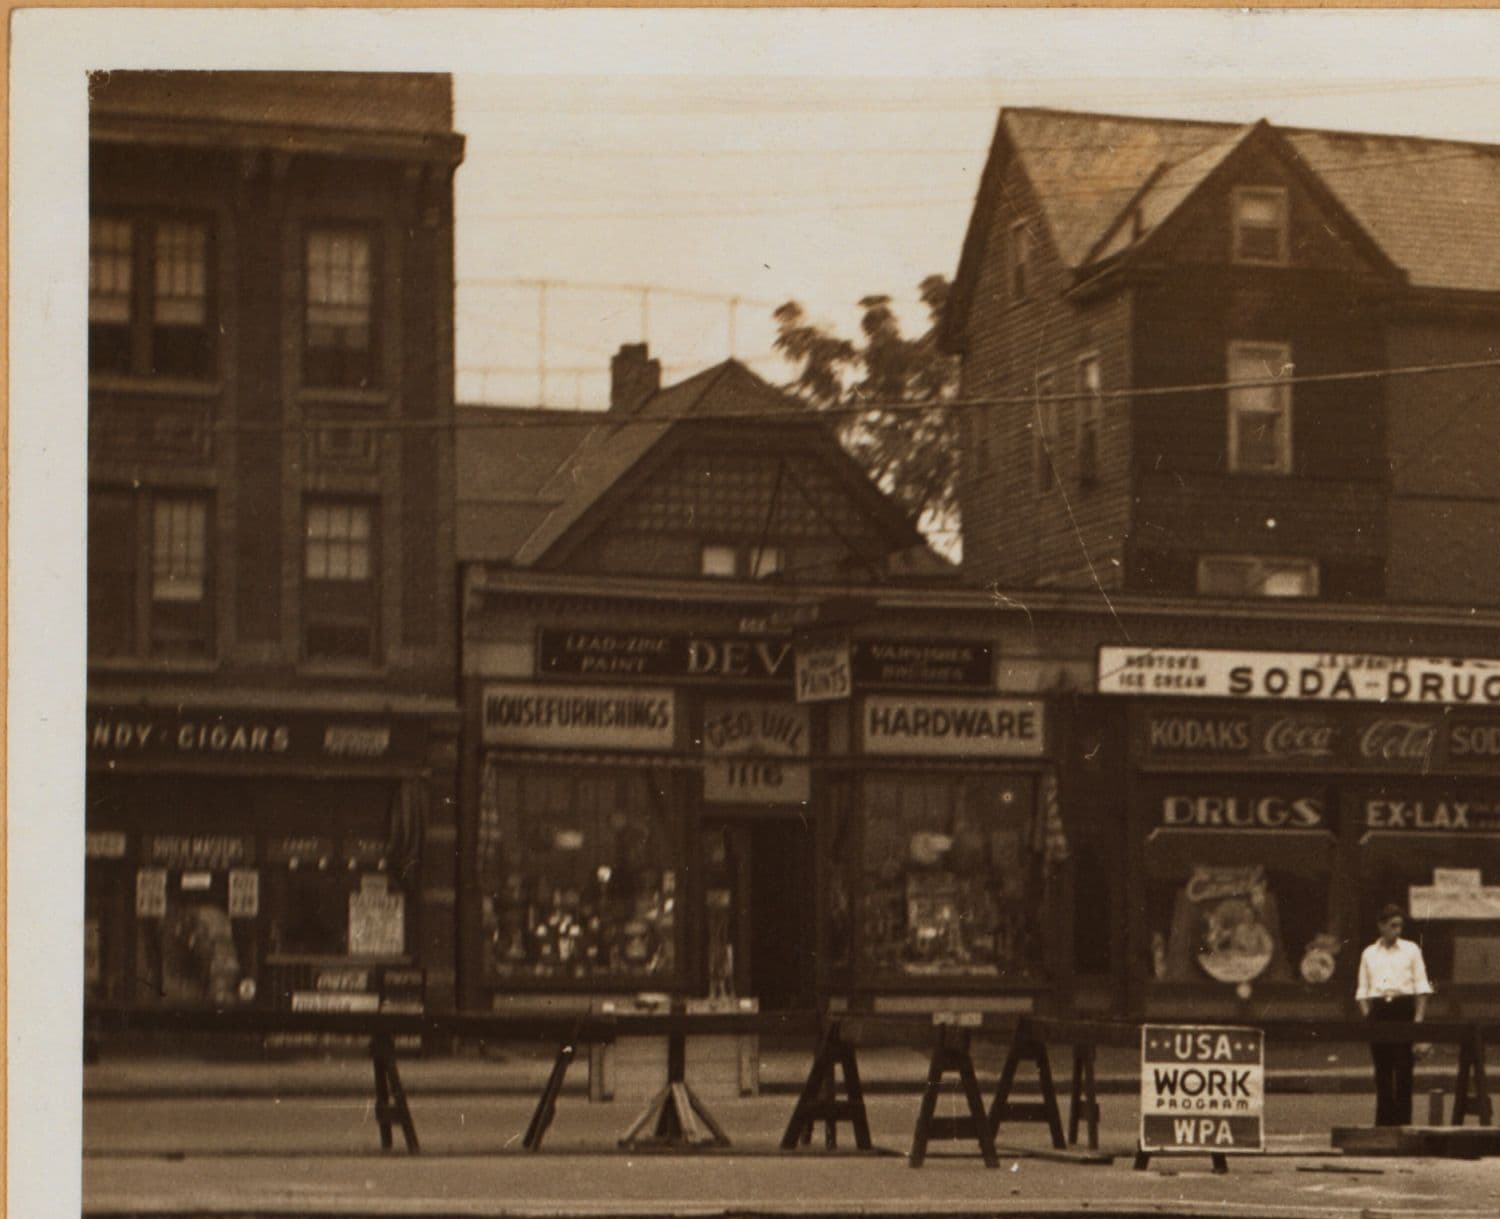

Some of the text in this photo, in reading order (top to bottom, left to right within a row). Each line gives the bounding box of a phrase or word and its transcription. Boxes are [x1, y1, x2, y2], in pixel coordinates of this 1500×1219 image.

[1119, 674, 1207, 689] ICE CREAM
[486, 695, 670, 730] HOUSEFURNISHINGS
[868, 707, 1037, 740] HARDWARE
[177, 724, 291, 753] CIGARS
[1150, 719, 1248, 750] KODAKS
[1262, 717, 1336, 758] Coca
[1360, 718, 1436, 761] Cola
[728, 760, 784, 788] 1116
[1163, 796, 1322, 826] DRUGS
[1174, 1033, 1233, 1061] USA
[1154, 1069, 1251, 1097] WORK
[1156, 1098, 1248, 1111] PROGRAM
[1173, 1119, 1234, 1145] WPA
